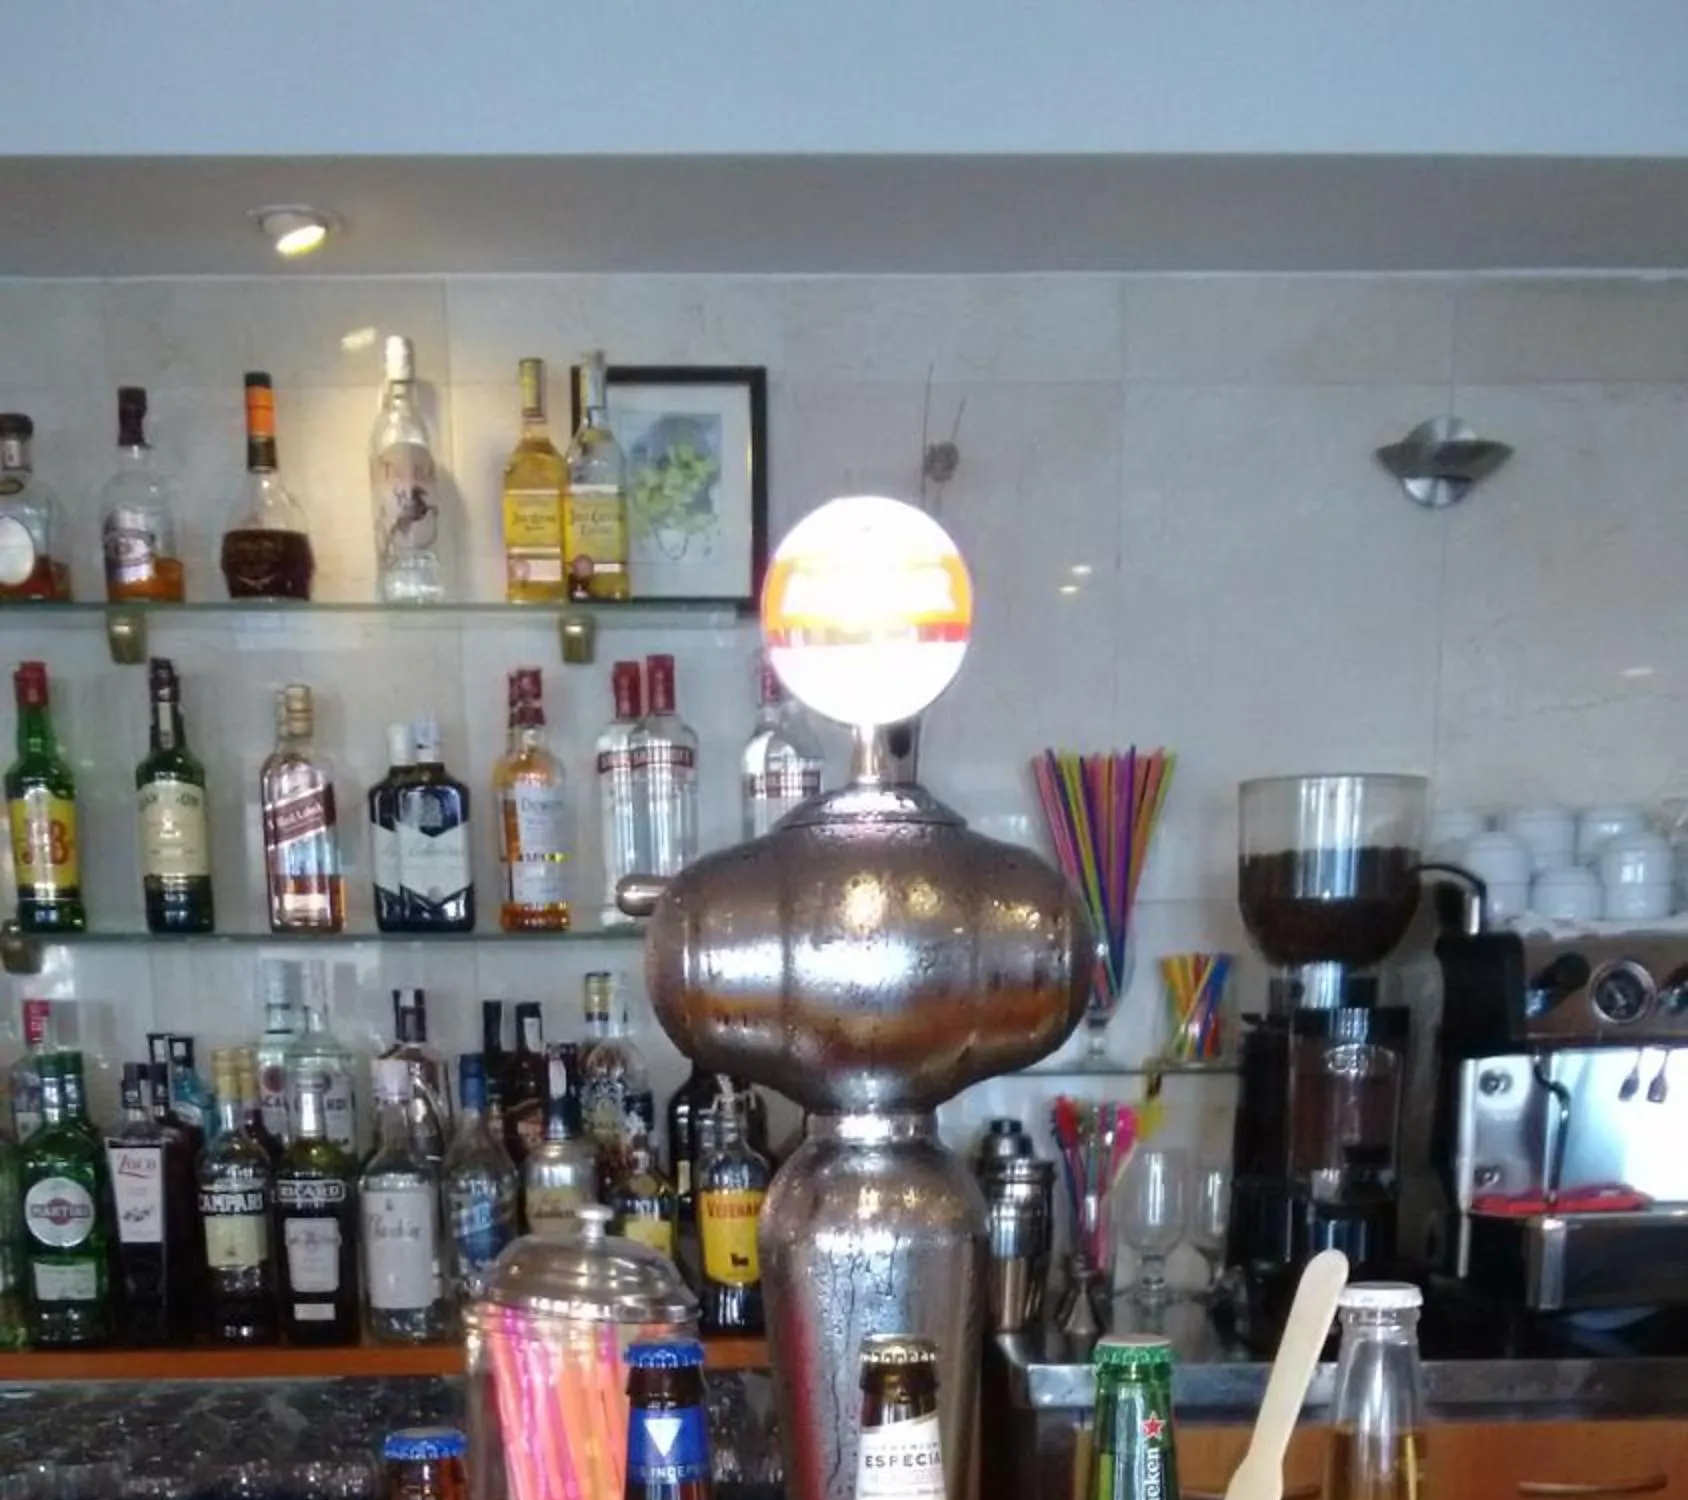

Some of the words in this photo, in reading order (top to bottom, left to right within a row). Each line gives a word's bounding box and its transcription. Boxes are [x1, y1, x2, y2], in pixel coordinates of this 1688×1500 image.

[199, 1192, 263, 1213] CAMPARI
[704, 1197, 762, 1217] VETERAN
[865, 1450, 941, 1468] ESPECIA
